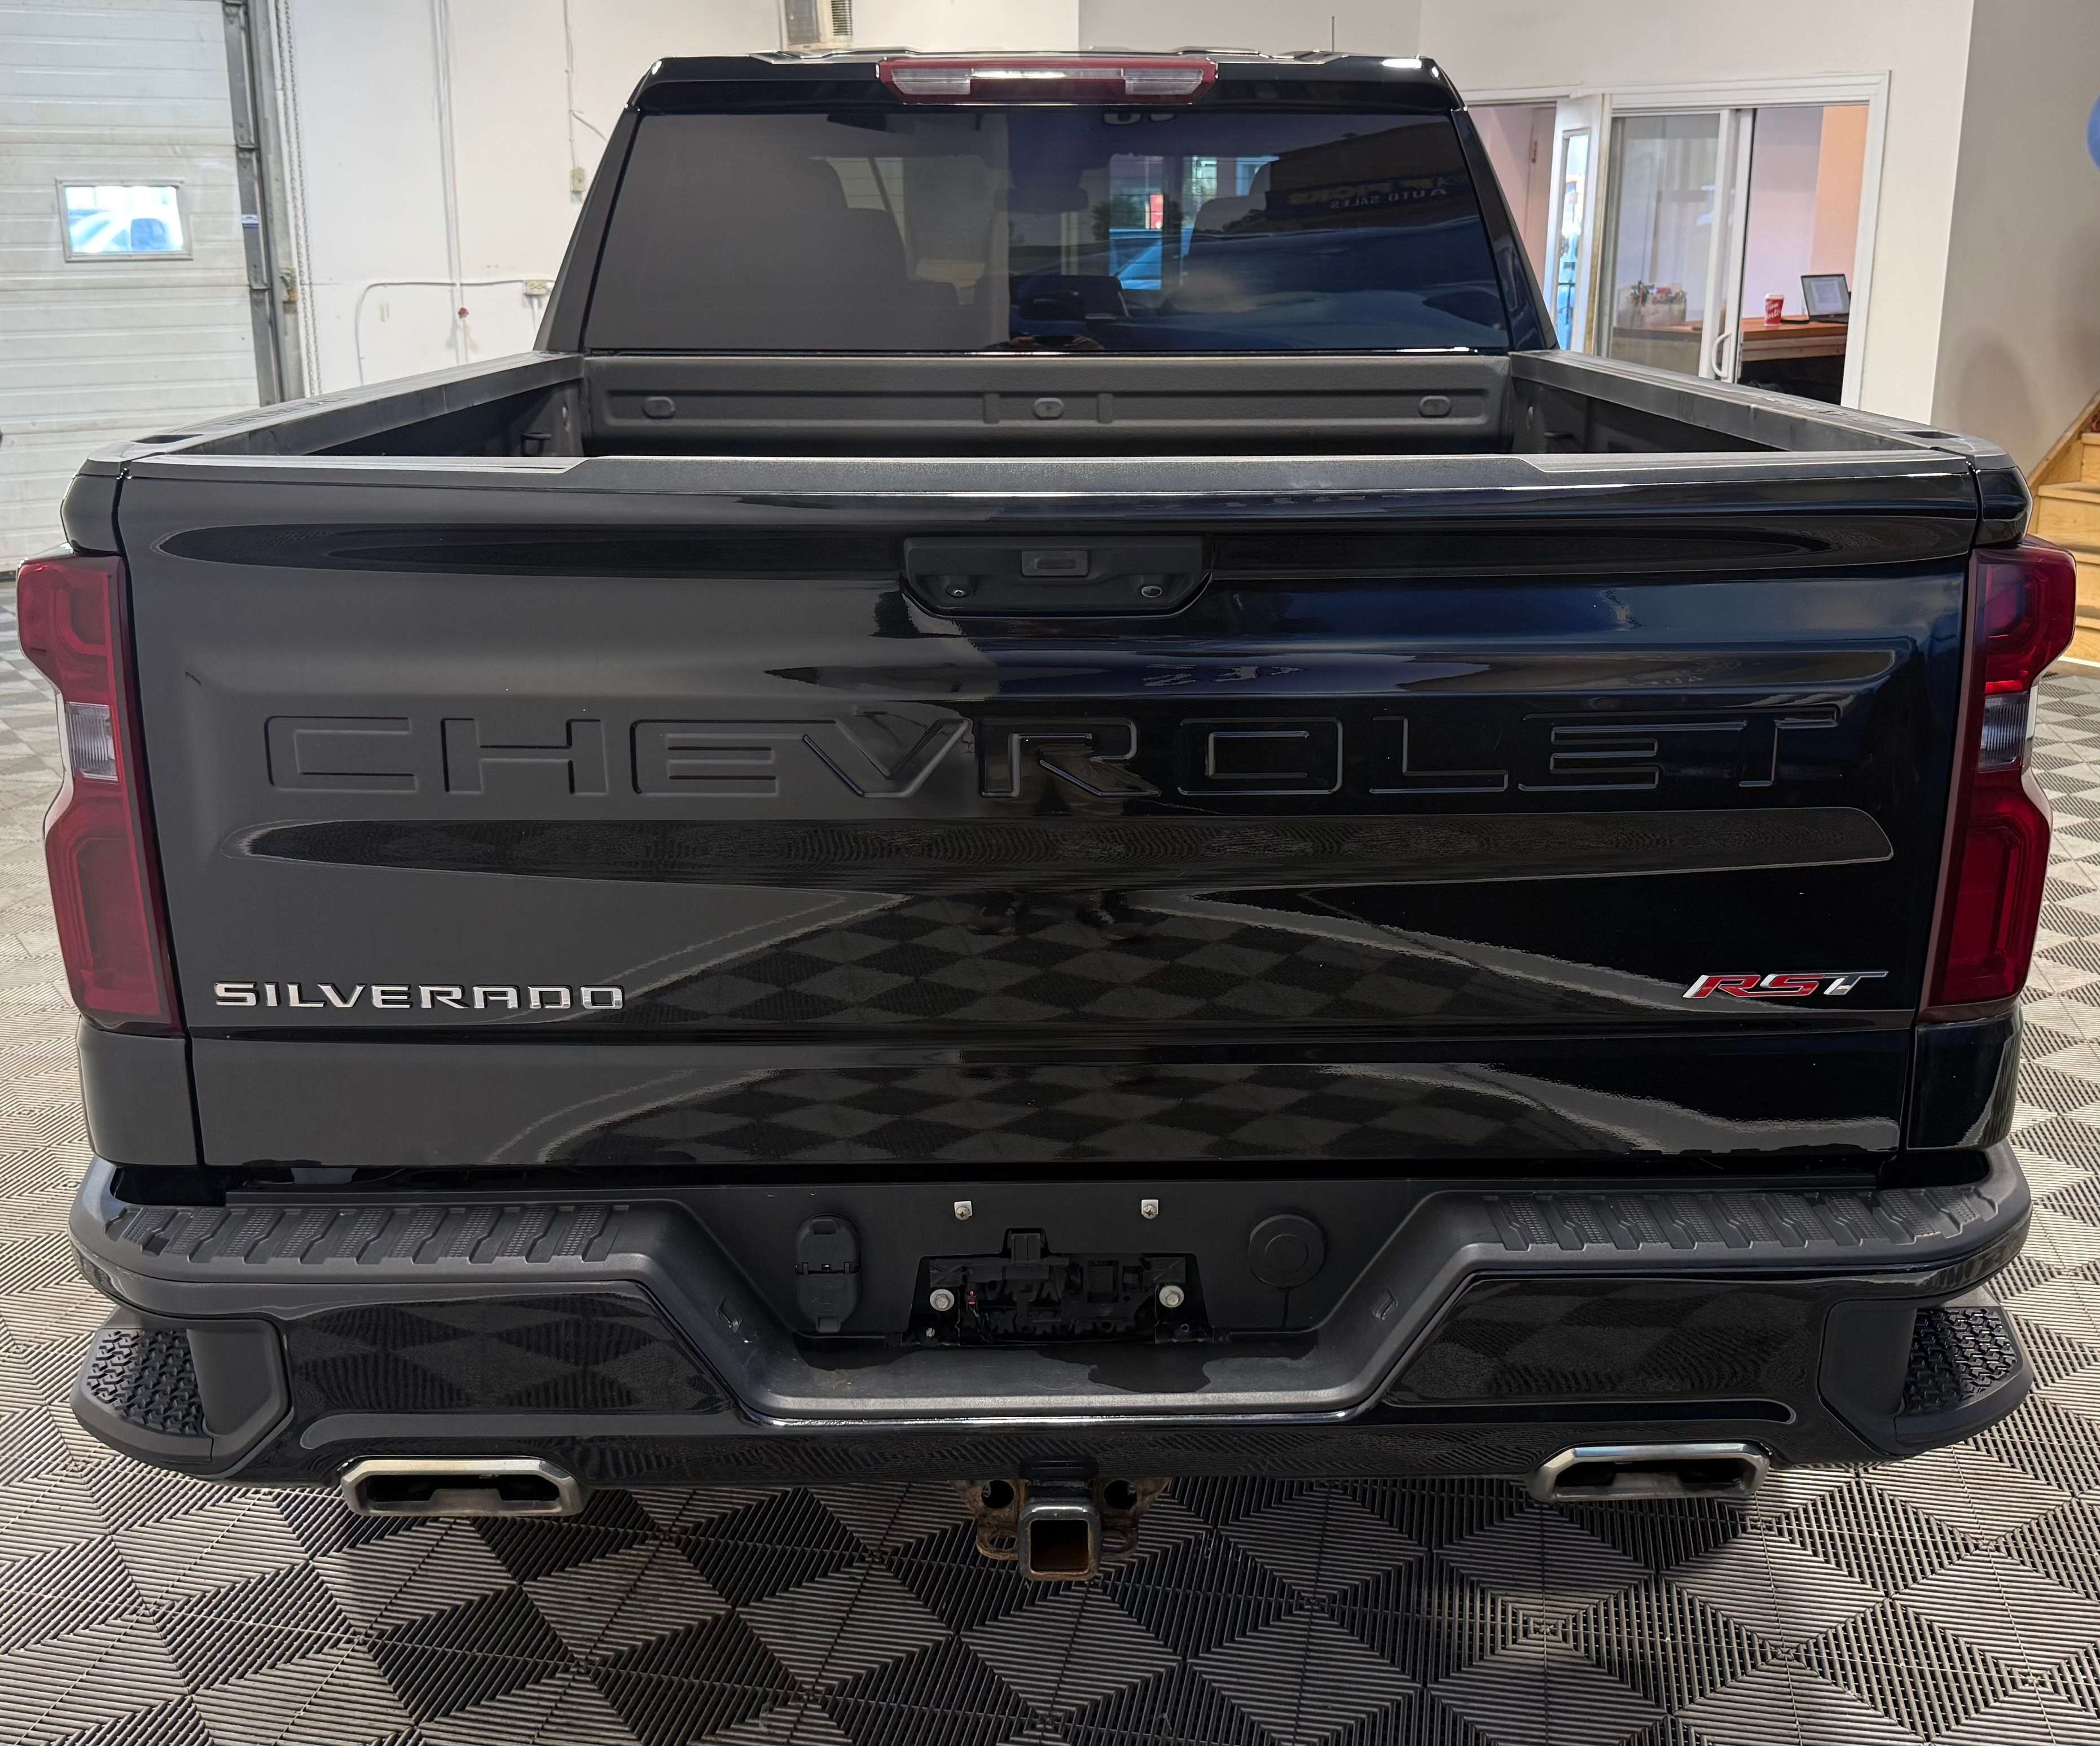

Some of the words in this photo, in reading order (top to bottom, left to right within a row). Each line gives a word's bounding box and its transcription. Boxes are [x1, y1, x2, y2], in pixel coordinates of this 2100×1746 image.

[263, 703, 1842, 797] CHEVROLET
[215, 983, 625, 1010] SILVERADO
[1682, 971, 1888, 999] RST
